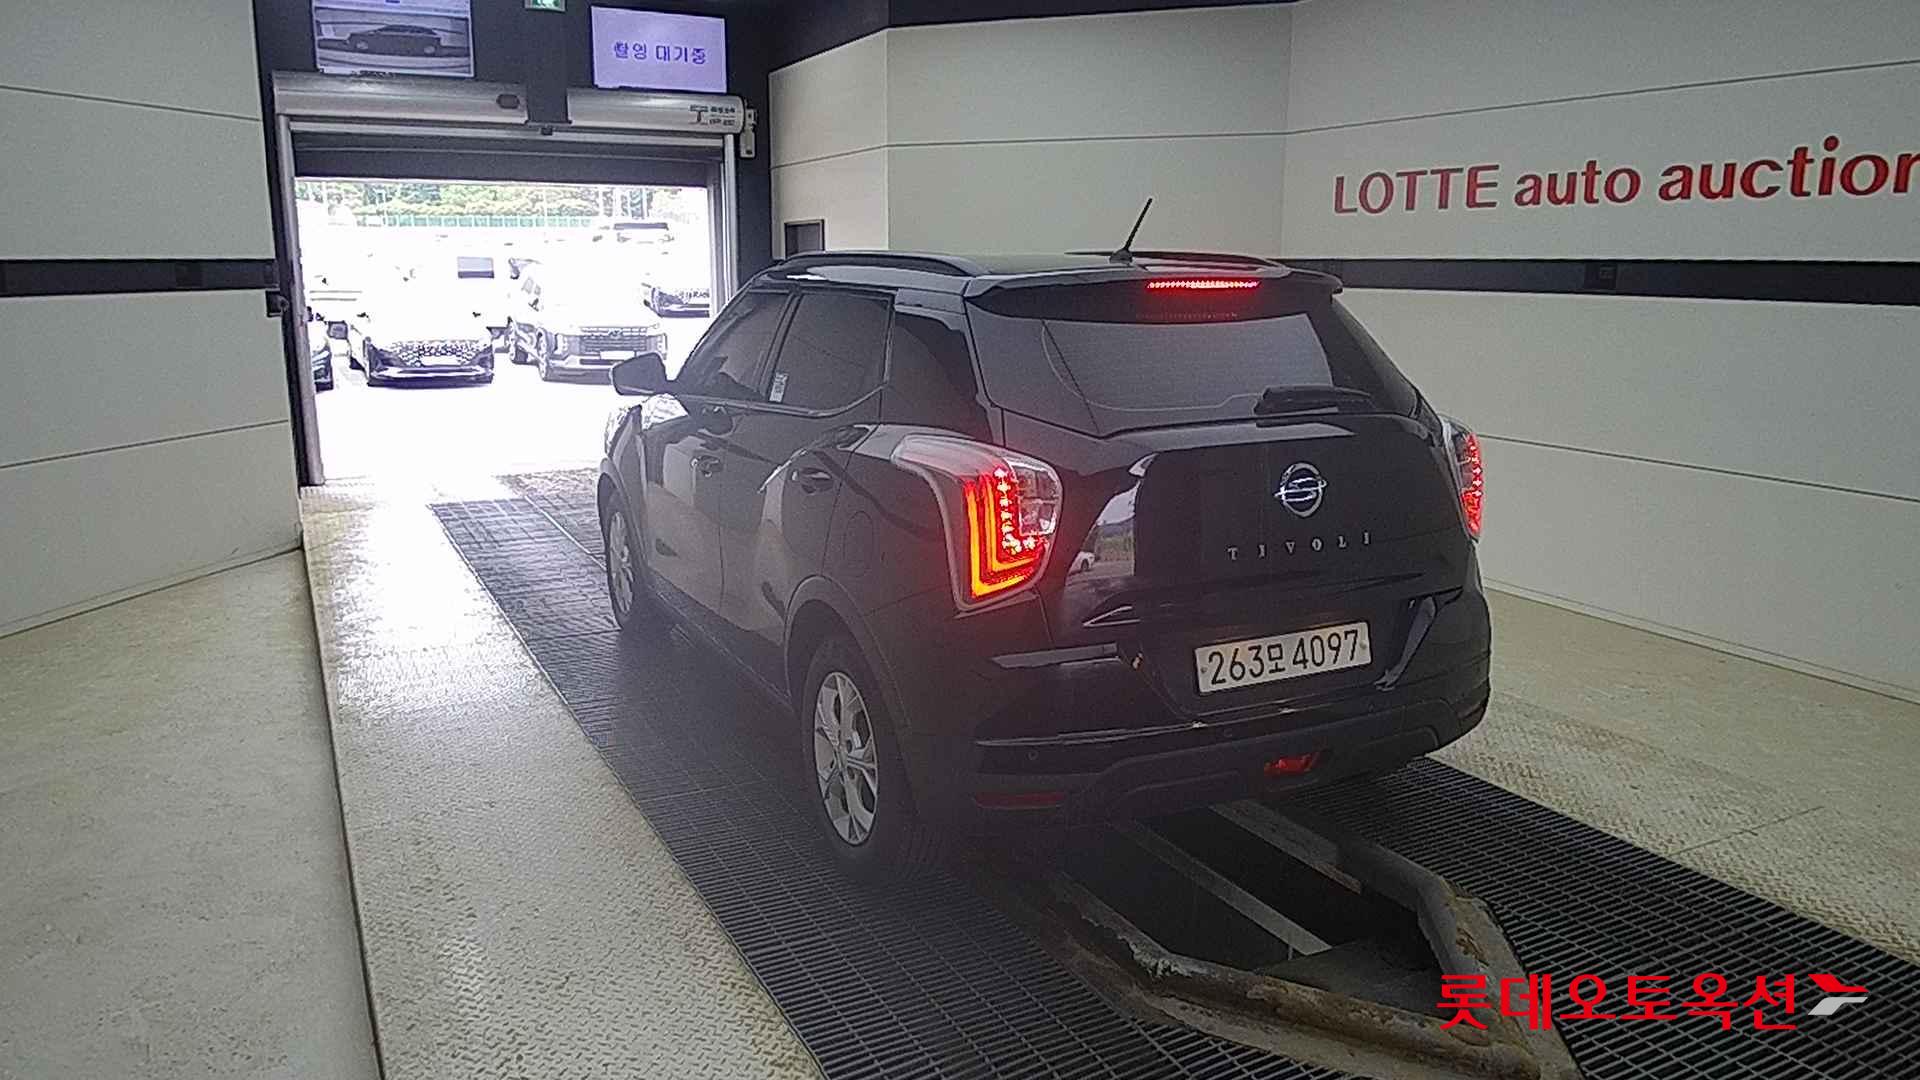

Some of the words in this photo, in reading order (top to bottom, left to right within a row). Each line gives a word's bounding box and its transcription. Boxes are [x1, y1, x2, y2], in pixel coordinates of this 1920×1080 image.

[655, 45, 706, 65] 대기중
[1333, 164, 1500, 215] LOTTE
[1514, 160, 1641, 207] auto
[1227, 531, 1371, 561] TIVOLI
